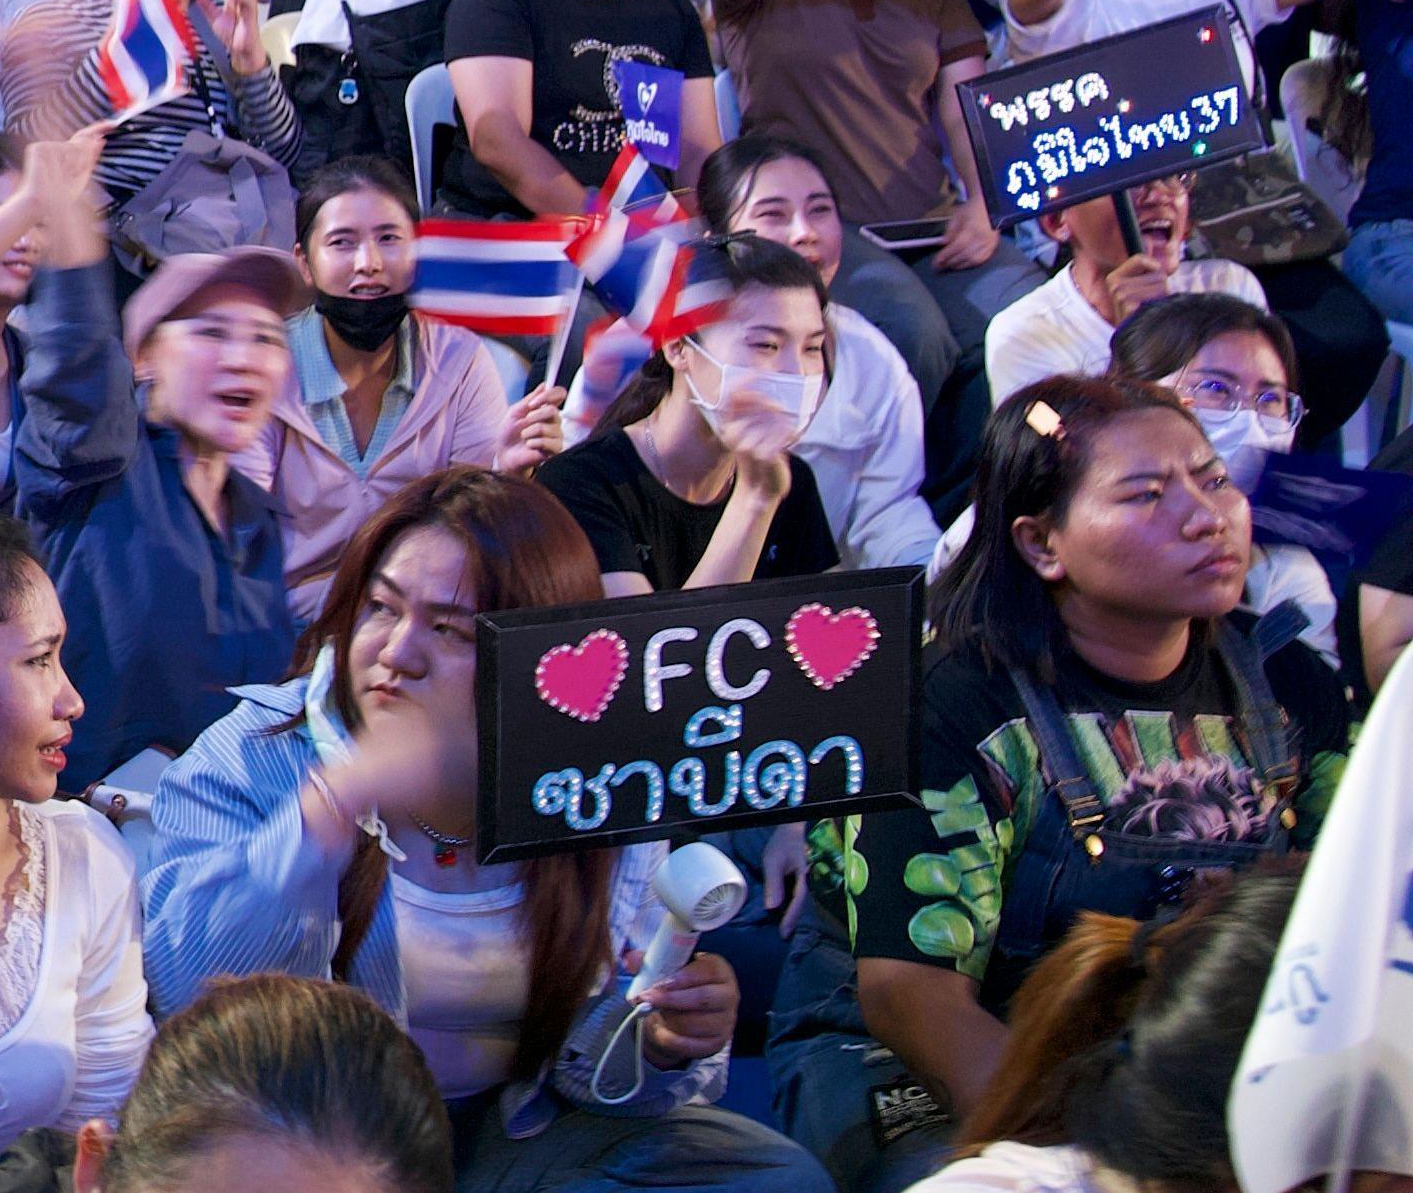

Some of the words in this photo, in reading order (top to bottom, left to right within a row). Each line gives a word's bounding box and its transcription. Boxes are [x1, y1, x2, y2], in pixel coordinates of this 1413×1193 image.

[989, 71, 1109, 132] พรรค
[1006, 114, 1191, 211] ภูมิใจไทย
[1191, 86, 1240, 134] 37
[643, 617, 772, 713] FC
